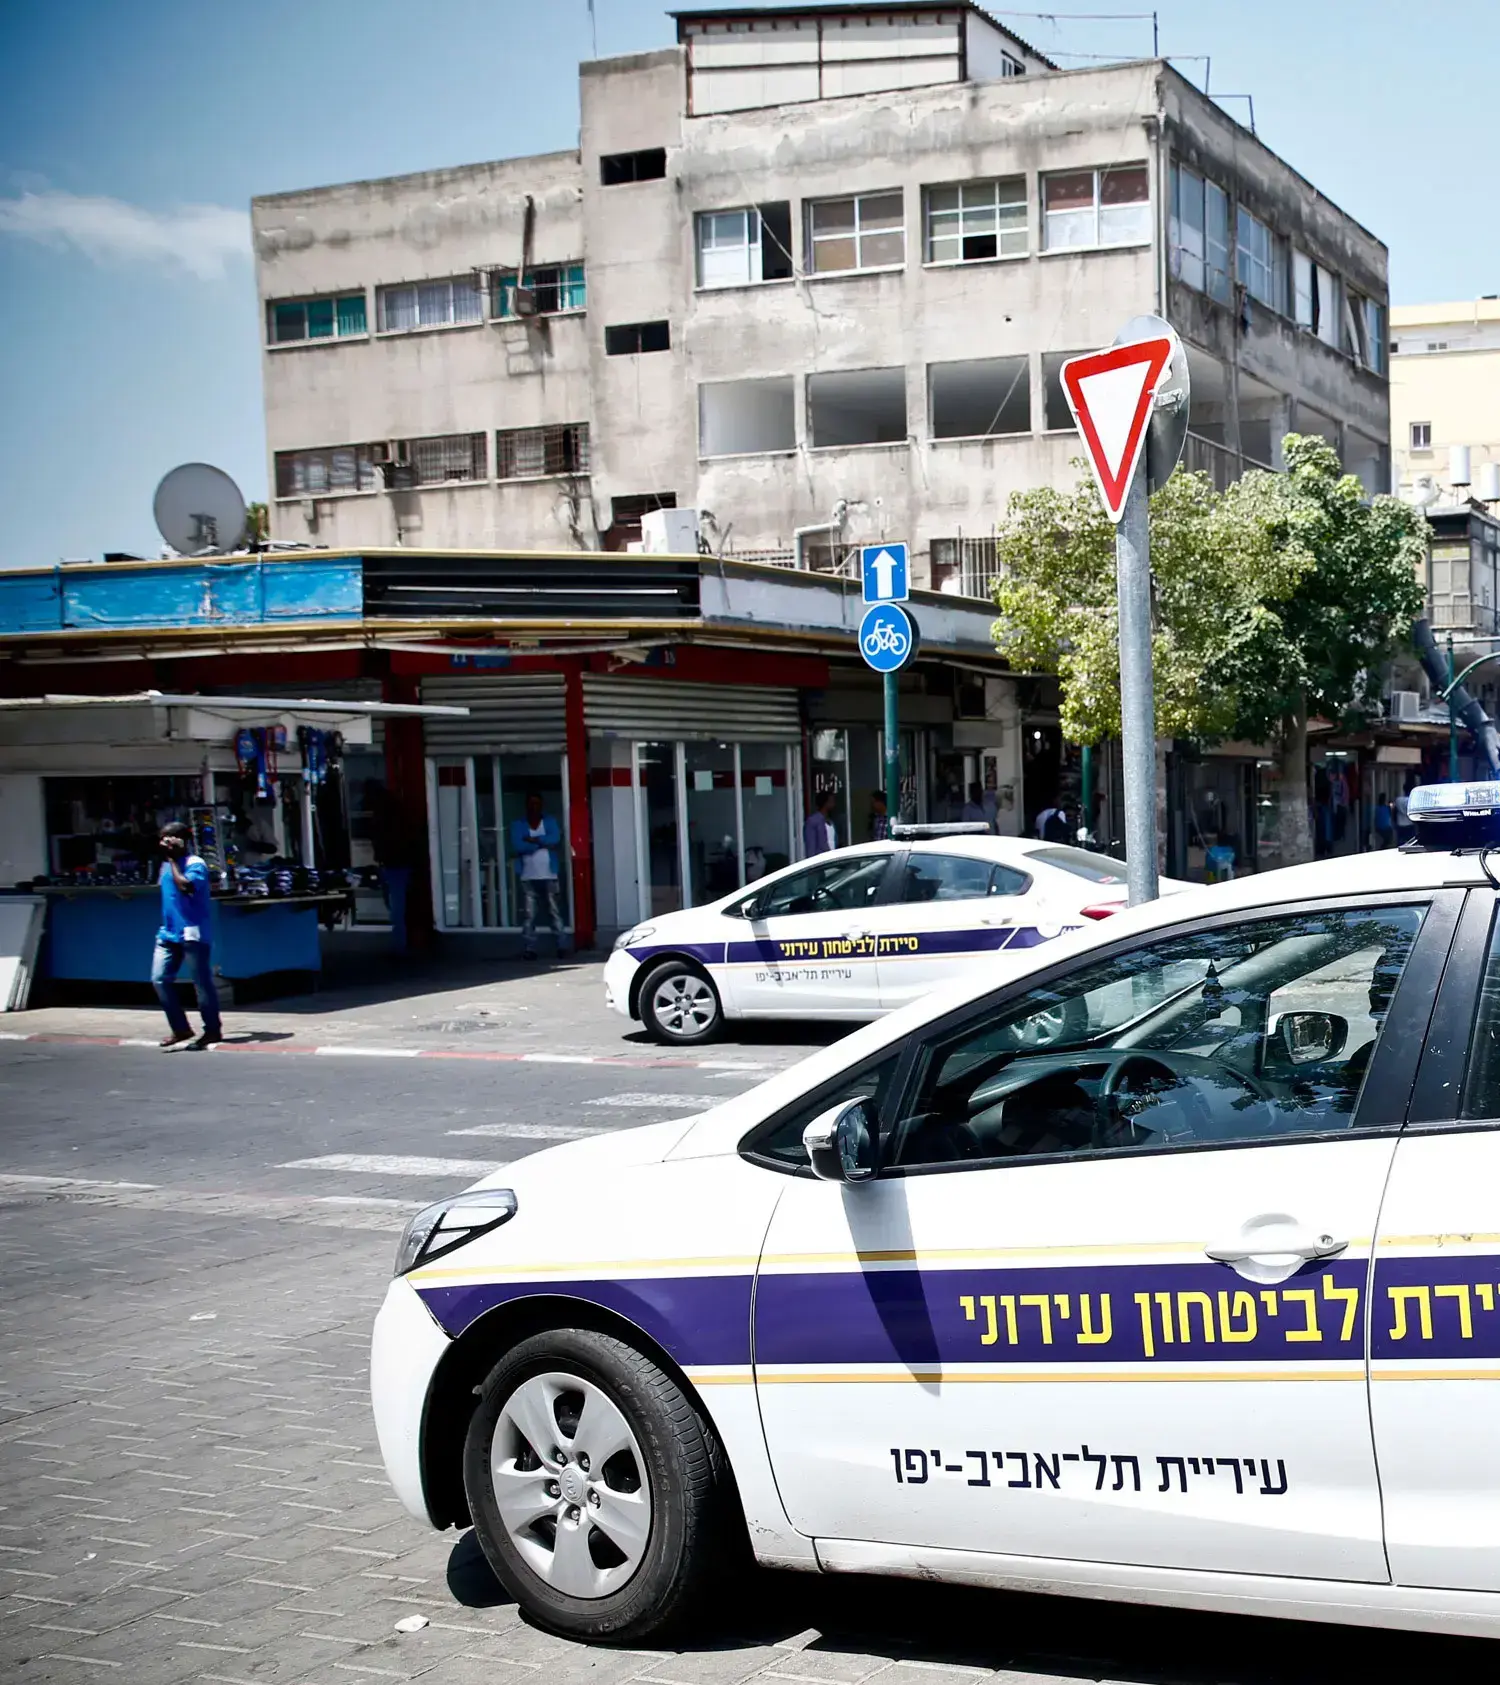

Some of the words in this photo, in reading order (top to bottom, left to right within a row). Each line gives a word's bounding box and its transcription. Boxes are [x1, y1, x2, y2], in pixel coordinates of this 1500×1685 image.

[779, 941, 818, 957] עירוני
[822, 936, 875, 958] לביטחון
[879, 936, 919, 952] סיירת
[821, 968, 852, 980] עיריית
[960, 1294, 1113, 1345] עירוני
[1135, 1275, 1359, 1357] לביטחון
[1156, 1455, 1288, 1495] עיריית
